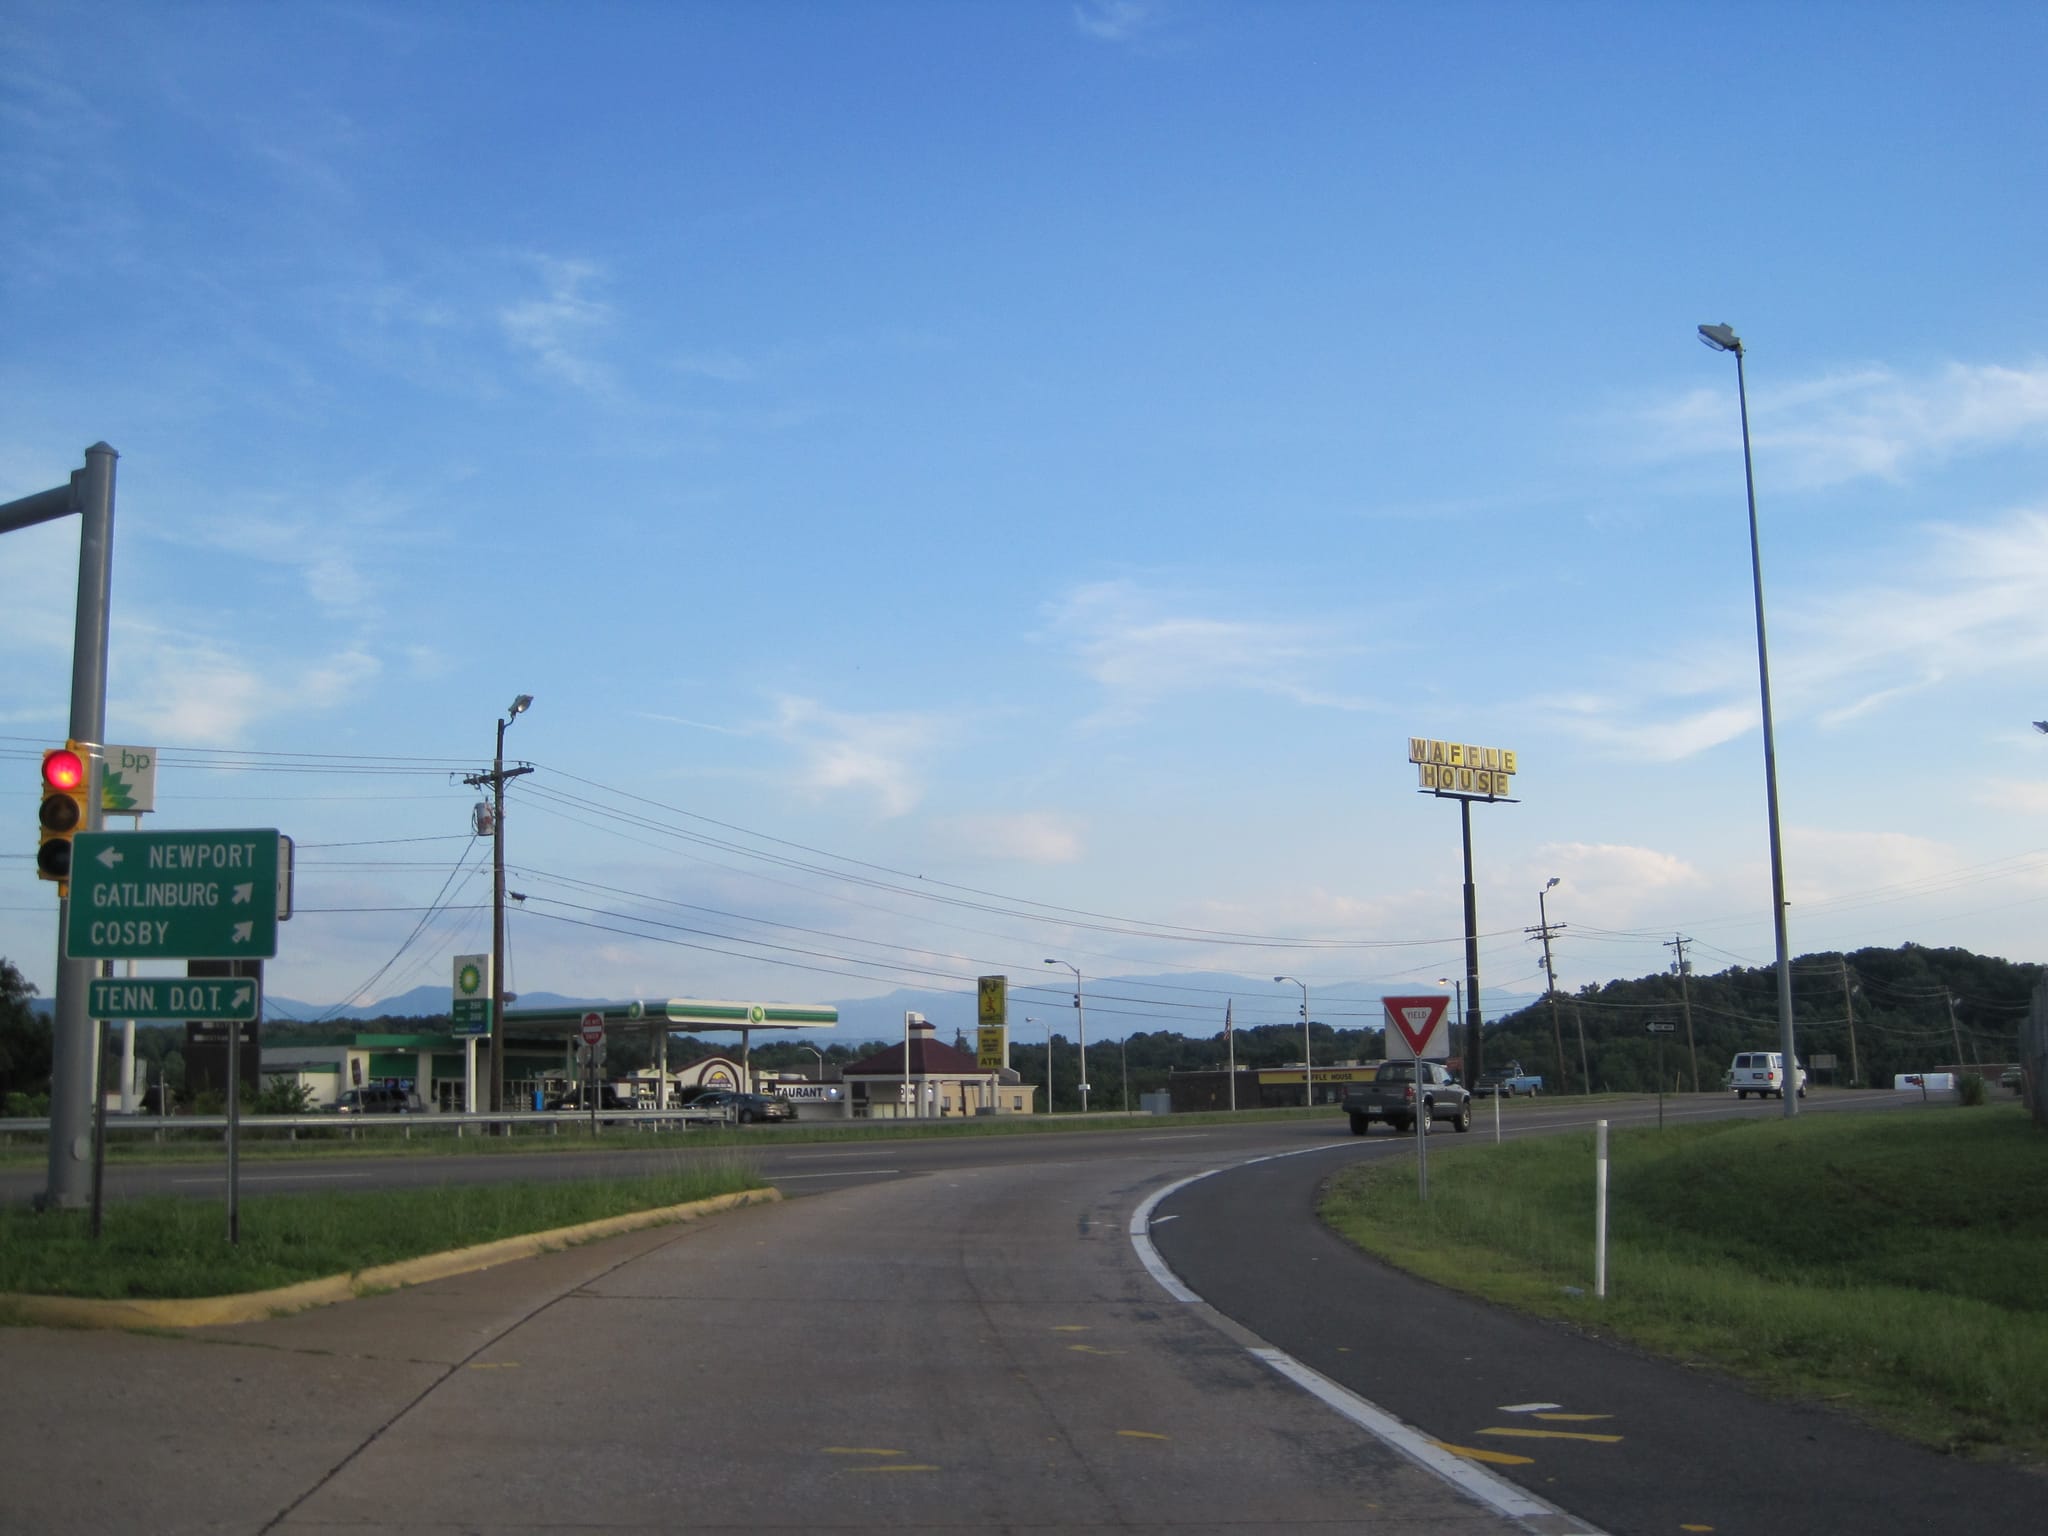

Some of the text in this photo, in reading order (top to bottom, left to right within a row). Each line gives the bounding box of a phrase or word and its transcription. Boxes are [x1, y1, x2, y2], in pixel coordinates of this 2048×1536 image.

[121, 749, 150, 773] bp
[1411, 738, 1513, 769] WAFFLE
[1422, 765, 1507, 795] HOUSE
[149, 844, 256, 869] NEWPORT
[93, 883, 219, 908] GATLINBURG
[91, 921, 169, 945] COSBY
[96, 986, 158, 1011] TENN.
[1407, 1010, 1427, 1019] YIELD
[981, 1057, 1001, 1066] ATM
